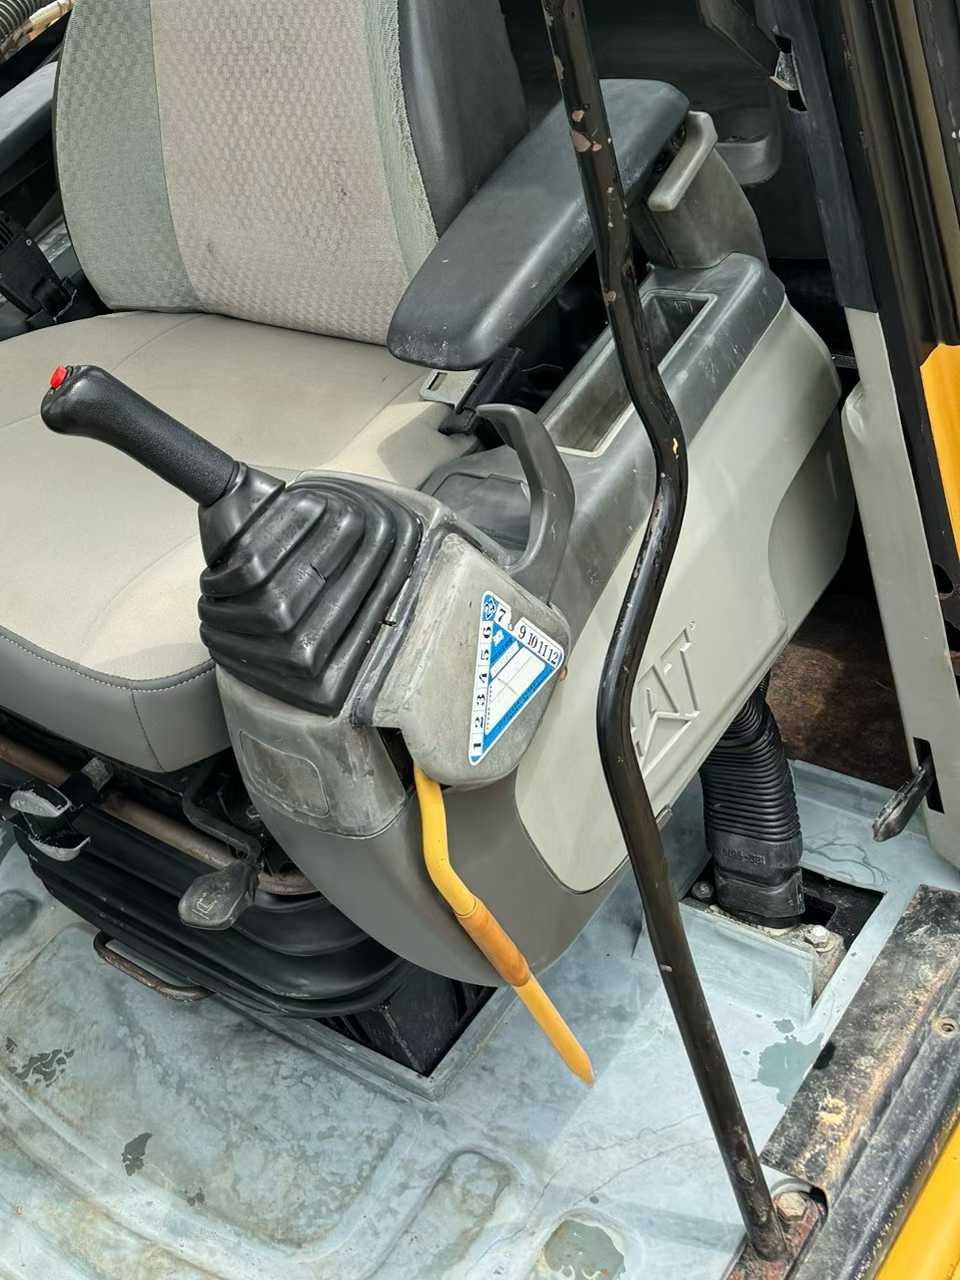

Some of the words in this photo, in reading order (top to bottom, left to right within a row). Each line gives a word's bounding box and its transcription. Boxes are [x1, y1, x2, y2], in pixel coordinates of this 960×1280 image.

[483, 626, 491, 639] 6
[497, 608, 507, 622] 7
[518, 625, 526, 639] 9
[527, 632, 537, 649] 10
[538, 640, 548, 656] 11
[548, 648, 559, 665] 12
[480, 649, 489, 661] 5
[478, 673, 488, 683] 4
[476, 694, 485, 706] 3
[475, 717, 484, 728] 2
[473, 742, 481, 750] 1
